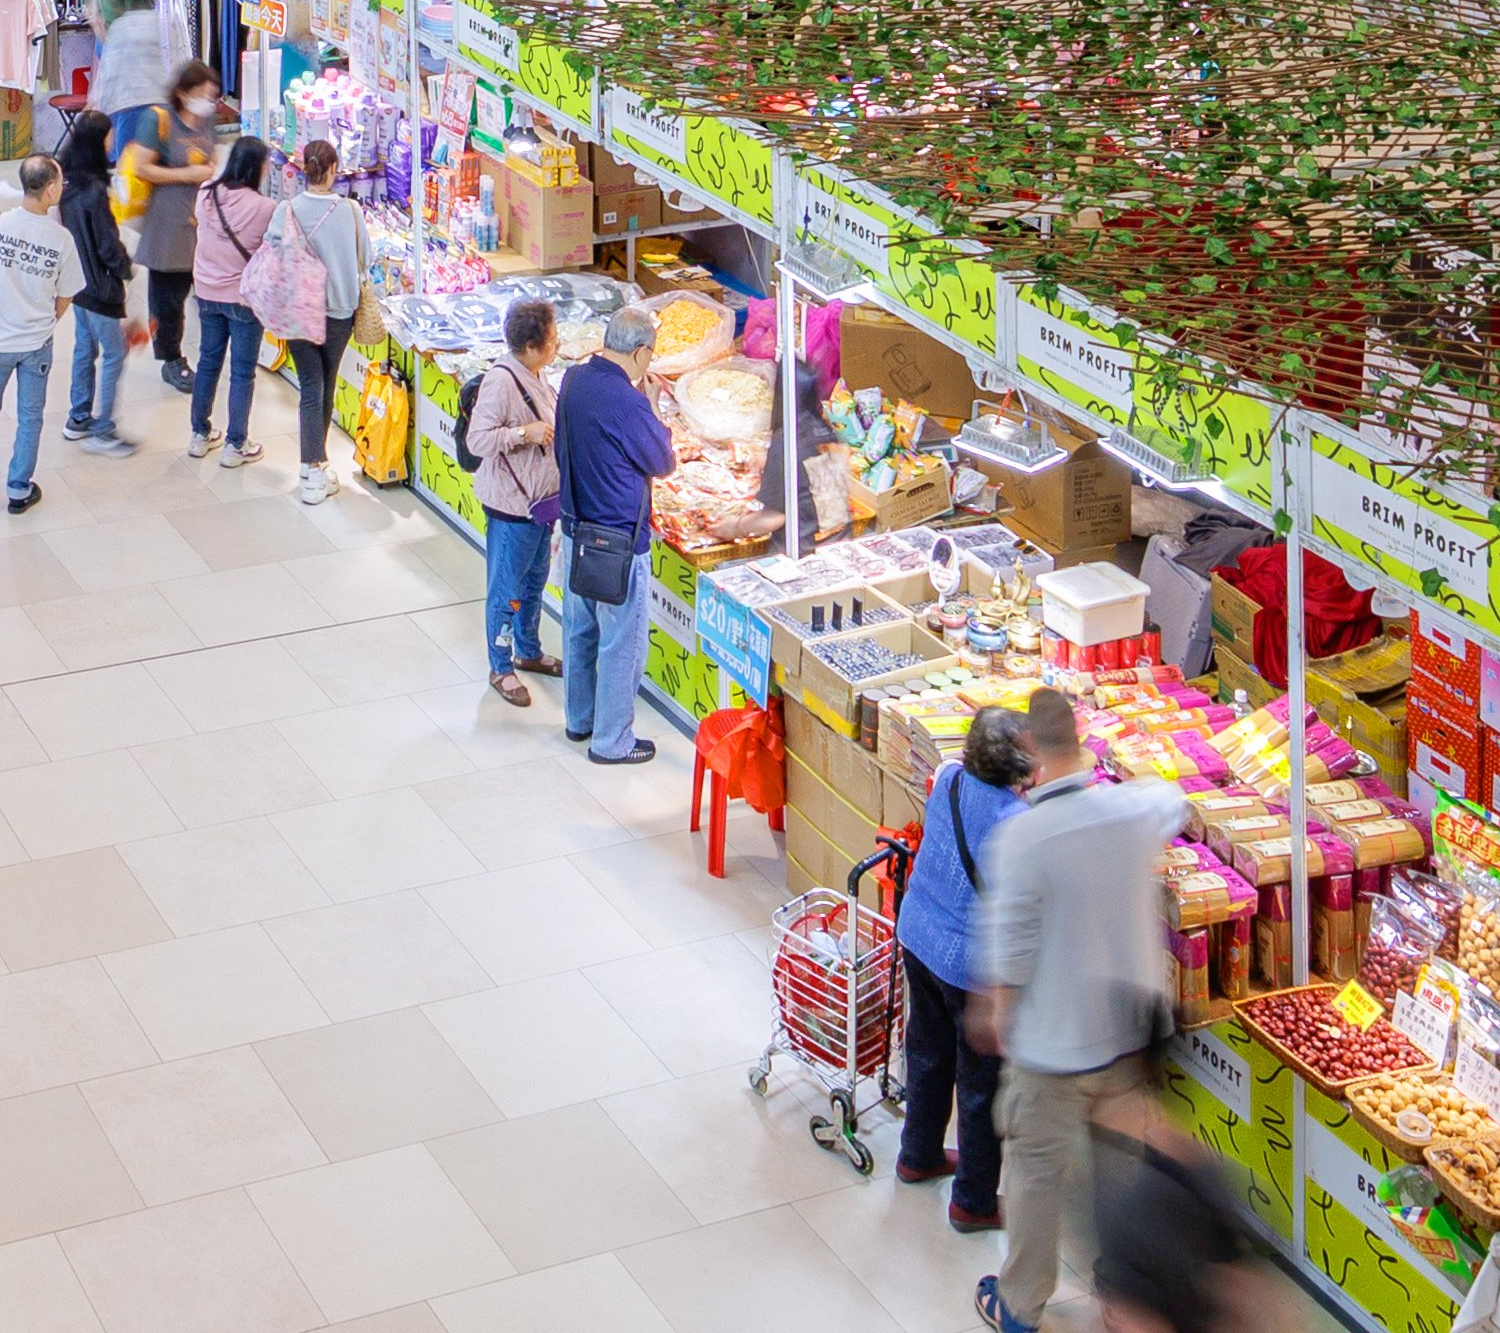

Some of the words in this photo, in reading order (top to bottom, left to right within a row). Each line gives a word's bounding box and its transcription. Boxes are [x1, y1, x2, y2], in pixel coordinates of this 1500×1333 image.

[626, 102, 647, 123] BRIM
[650, 113, 680, 141] PROFIT
[845, 218, 880, 248] PROFIT
[20, 252, 38, 264] OUT
[31, 243, 59, 260] NEVER
[1040, 326, 1072, 355] BRIM
[1079, 346, 1122, 382] PROFIT
[1362, 495, 1405, 532] BRIM
[1414, 523, 1476, 568] PROFIT
[662, 597, 691, 629] PROFIT
[1192, 1037, 1243, 1087] PROFIT
